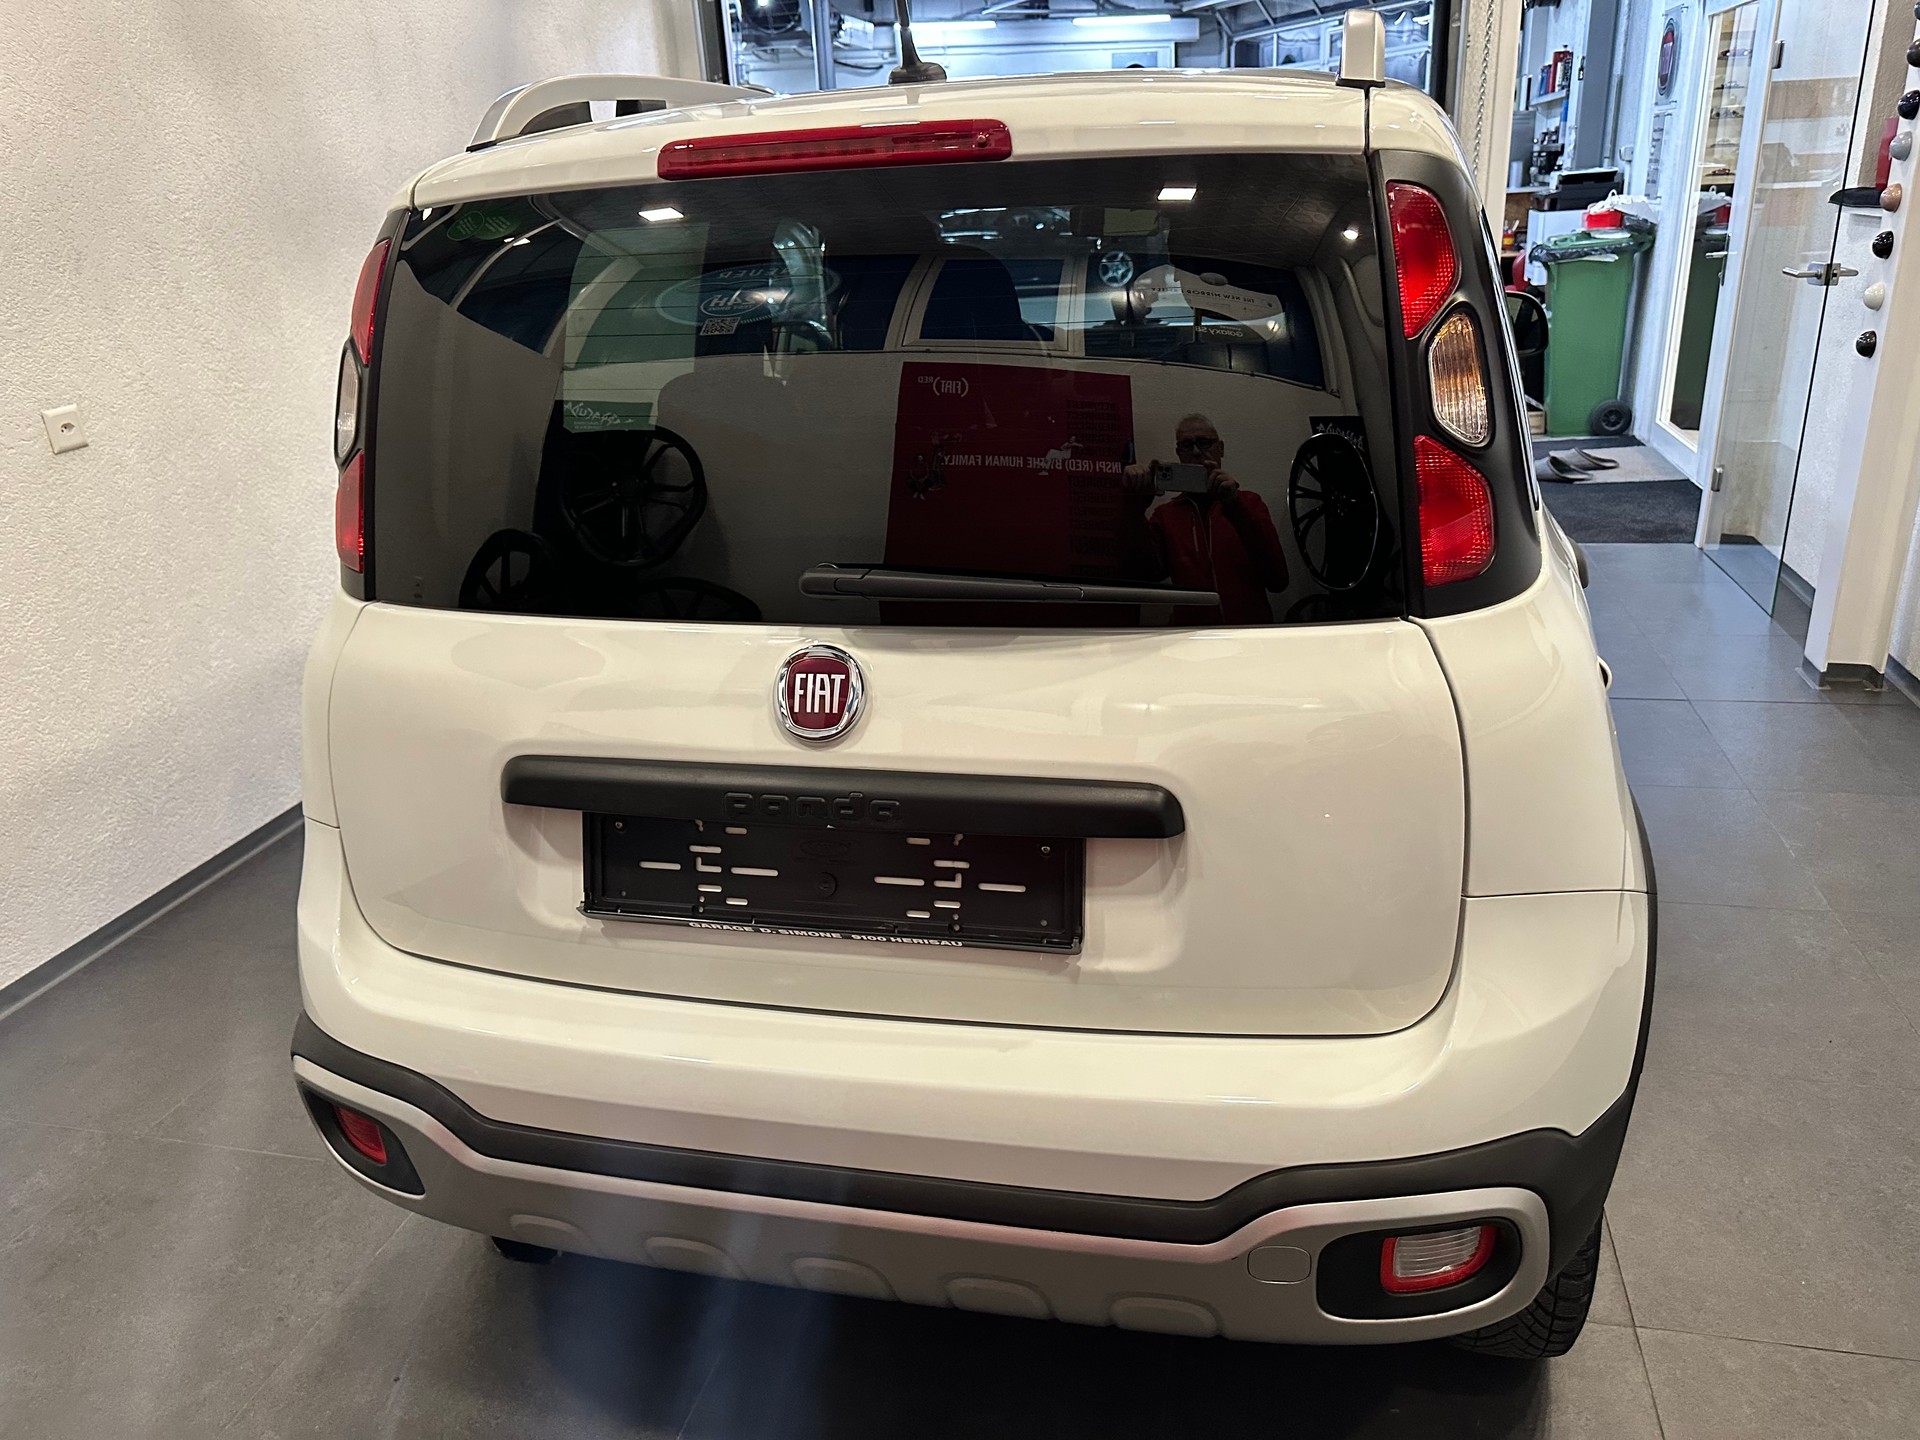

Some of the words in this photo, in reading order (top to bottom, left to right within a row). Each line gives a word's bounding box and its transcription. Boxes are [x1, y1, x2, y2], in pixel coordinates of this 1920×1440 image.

[792, 672, 846, 715] FIAT
[723, 790, 904, 823] panda
[688, 921, 755, 932] GARAGE
[759, 927, 777, 935] D.
[780, 929, 843, 939] SIMONE
[851, 934, 887, 943] 9100
[890, 936, 964, 948] HERISAU
